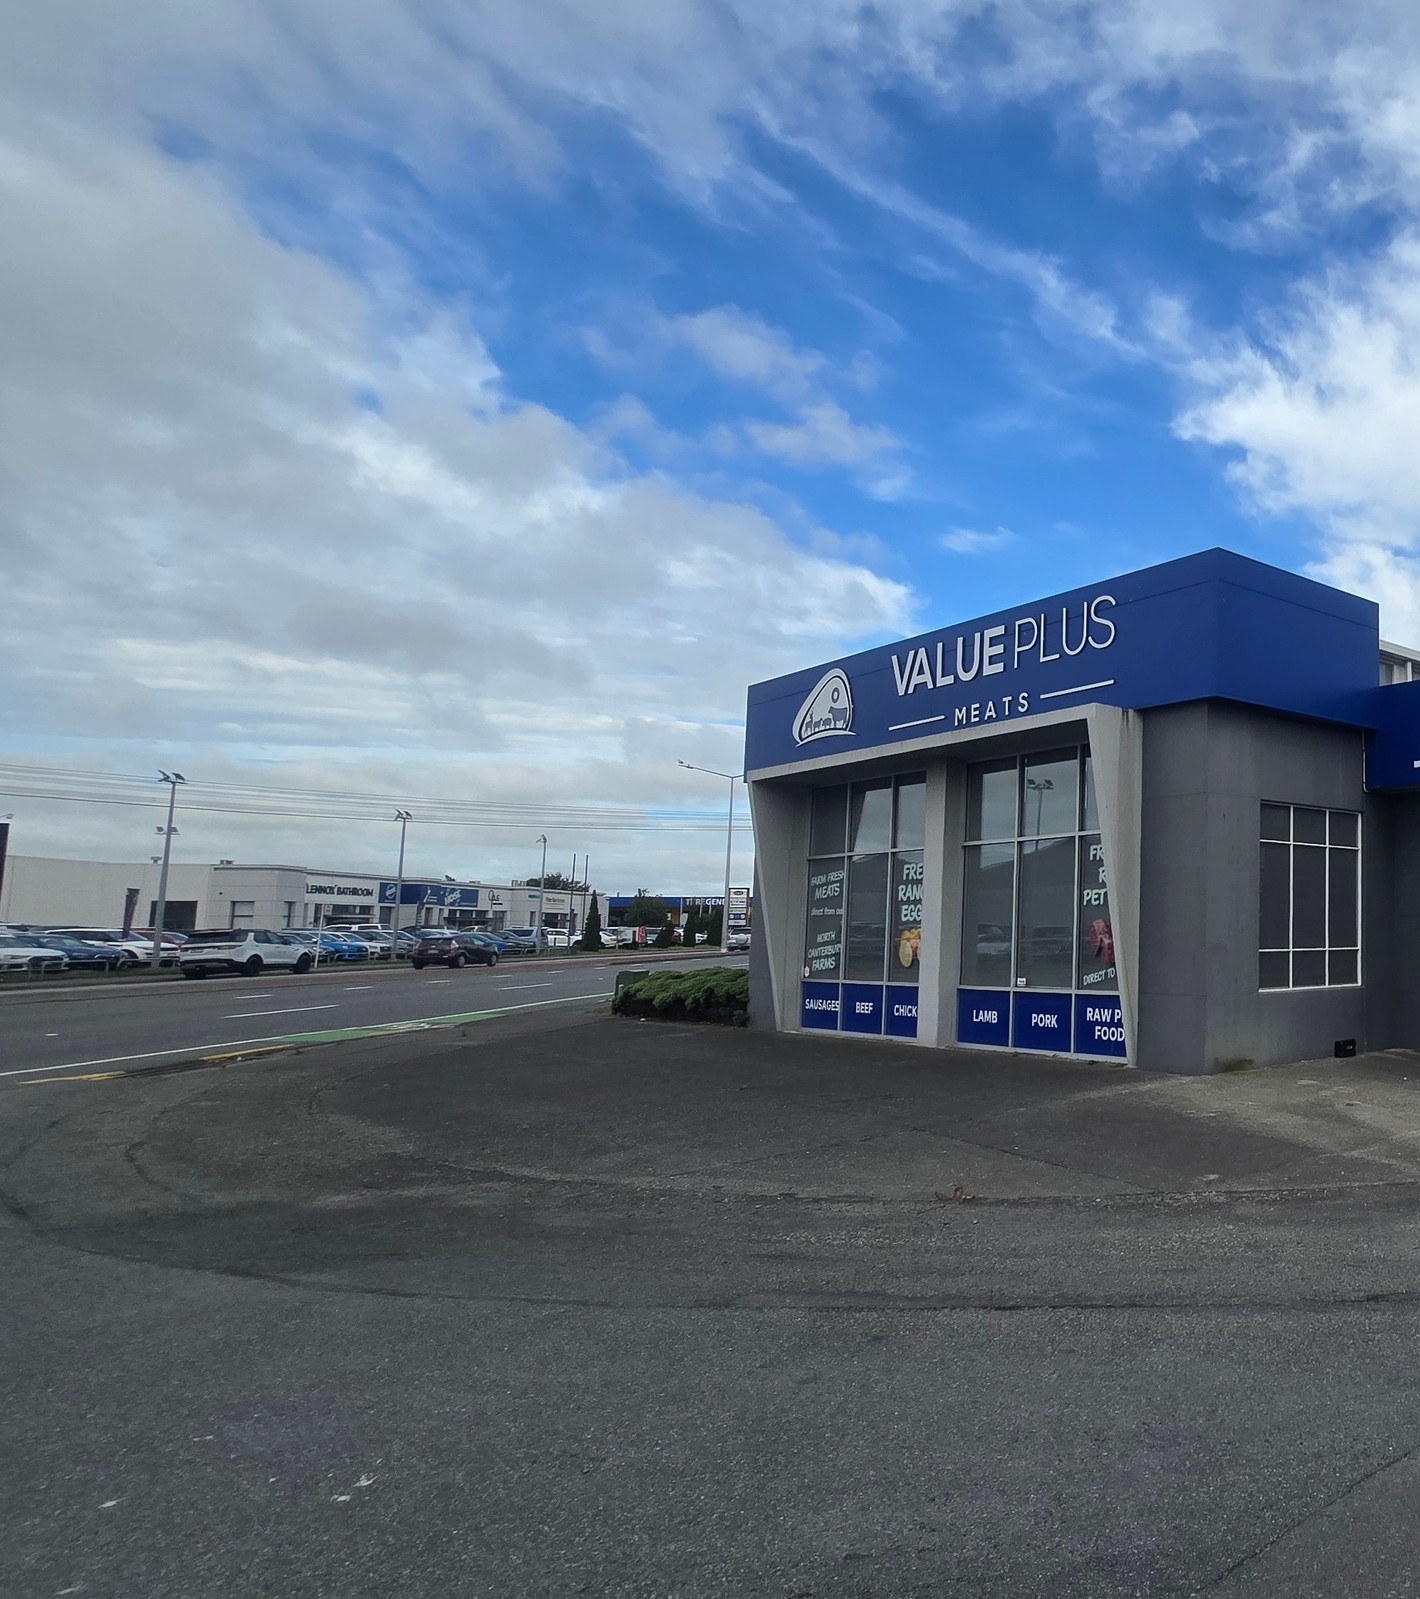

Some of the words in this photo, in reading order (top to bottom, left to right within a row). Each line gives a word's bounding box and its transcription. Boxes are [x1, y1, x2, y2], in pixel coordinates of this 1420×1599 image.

[891, 624, 1005, 696] VALUE
[1013, 595, 1117, 669] PLUS
[954, 692, 1029, 726] MEATS
[903, 863, 923, 880] FRE
[305, 883, 338, 895] LENNOX
[336, 886, 374, 897] BATHROOM
[815, 883, 840, 900] MEATS
[898, 884, 923, 901] RAN
[1083, 888, 1107, 906] PET
[901, 904, 922, 921] EGG
[816, 931, 836, 943] NORTH
[812, 957, 836, 971] FARMS
[1083, 970, 1106, 985] DIRECT
[805, 999, 839, 1012] SAUSAGES
[855, 1002, 873, 1014] BEEF
[894, 1004, 917, 1018] CHICK
[973, 1010, 998, 1024] LAMB
[1031, 1013, 1058, 1028] PORK
[1086, 1007, 1112, 1023] RAW
[1095, 1026, 1125, 1042] FOOD
